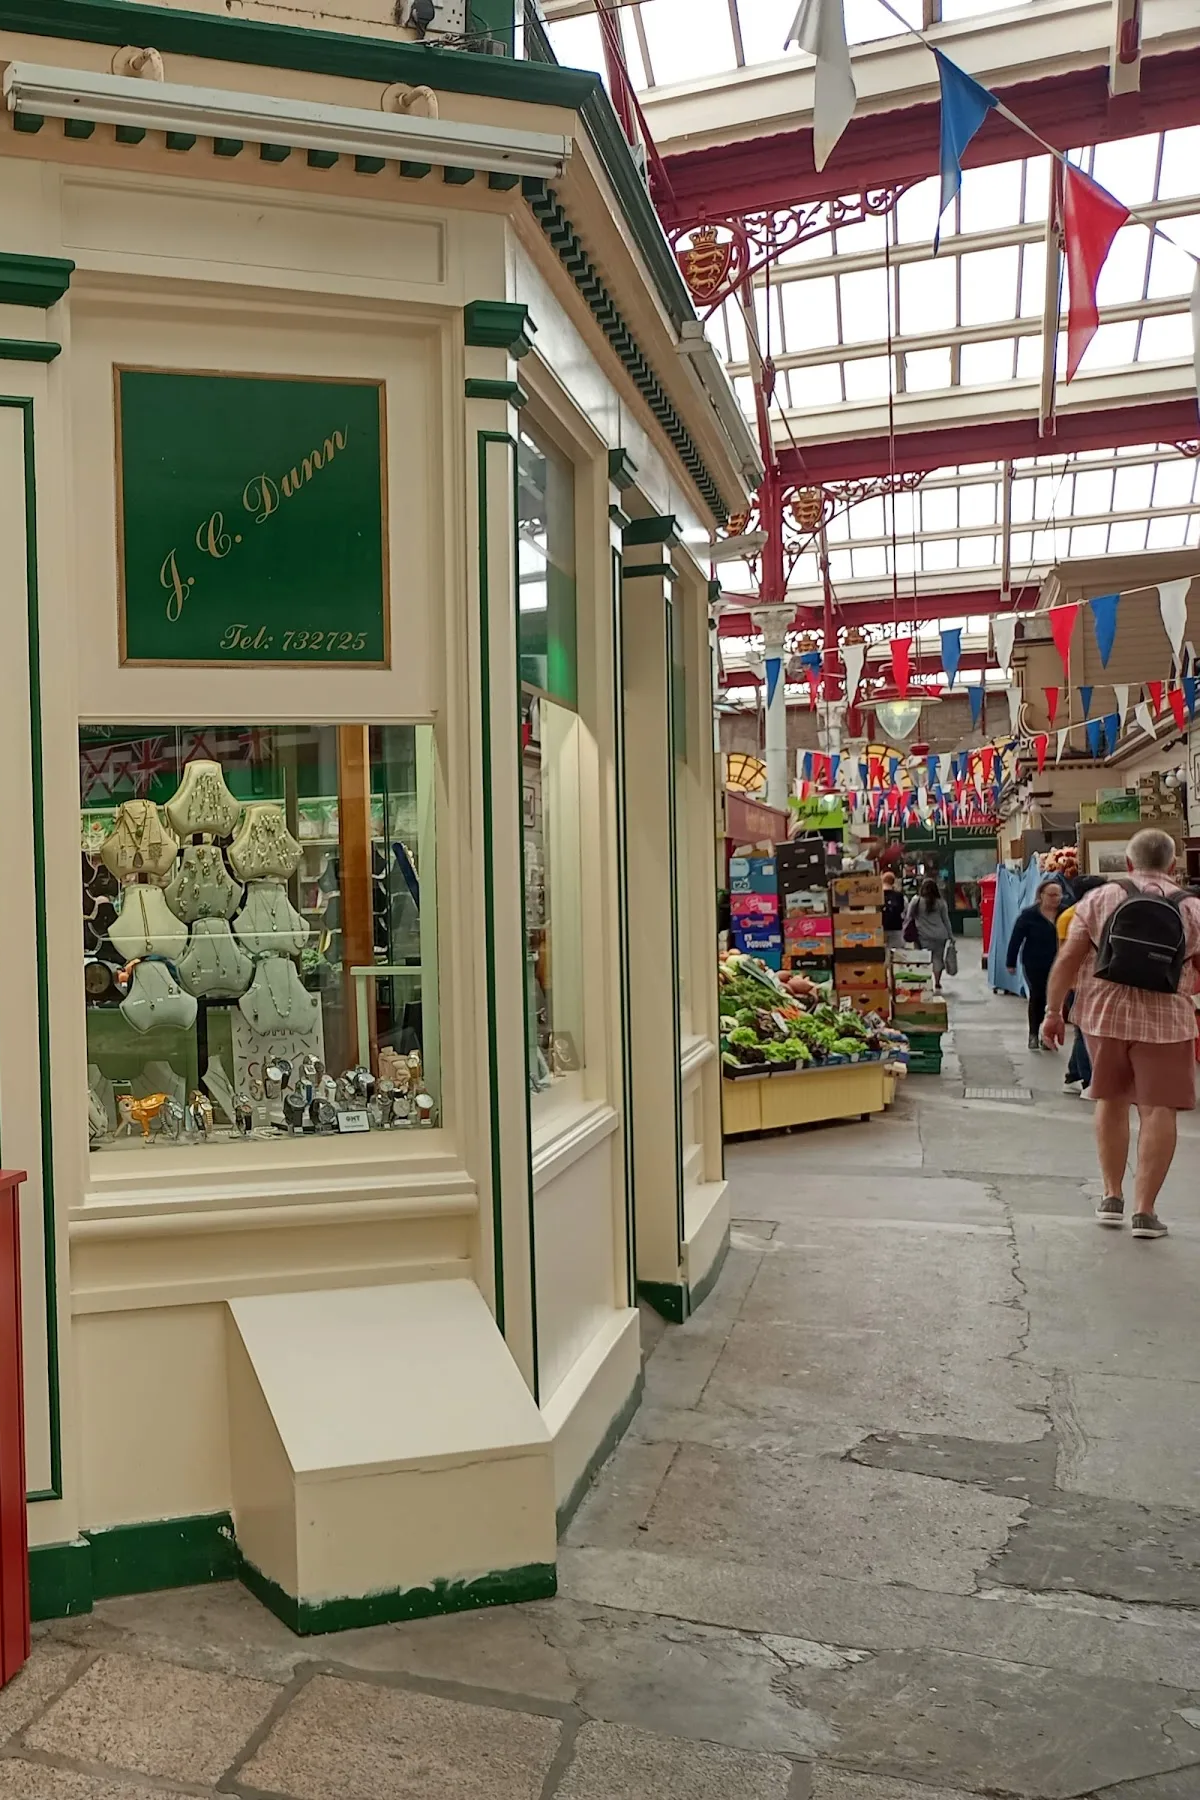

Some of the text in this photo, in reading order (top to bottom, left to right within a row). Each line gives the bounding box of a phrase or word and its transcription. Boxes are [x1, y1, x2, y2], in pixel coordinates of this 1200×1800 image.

[242, 423, 349, 524] Dunn
[219, 623, 368, 652] Tel: 732725
